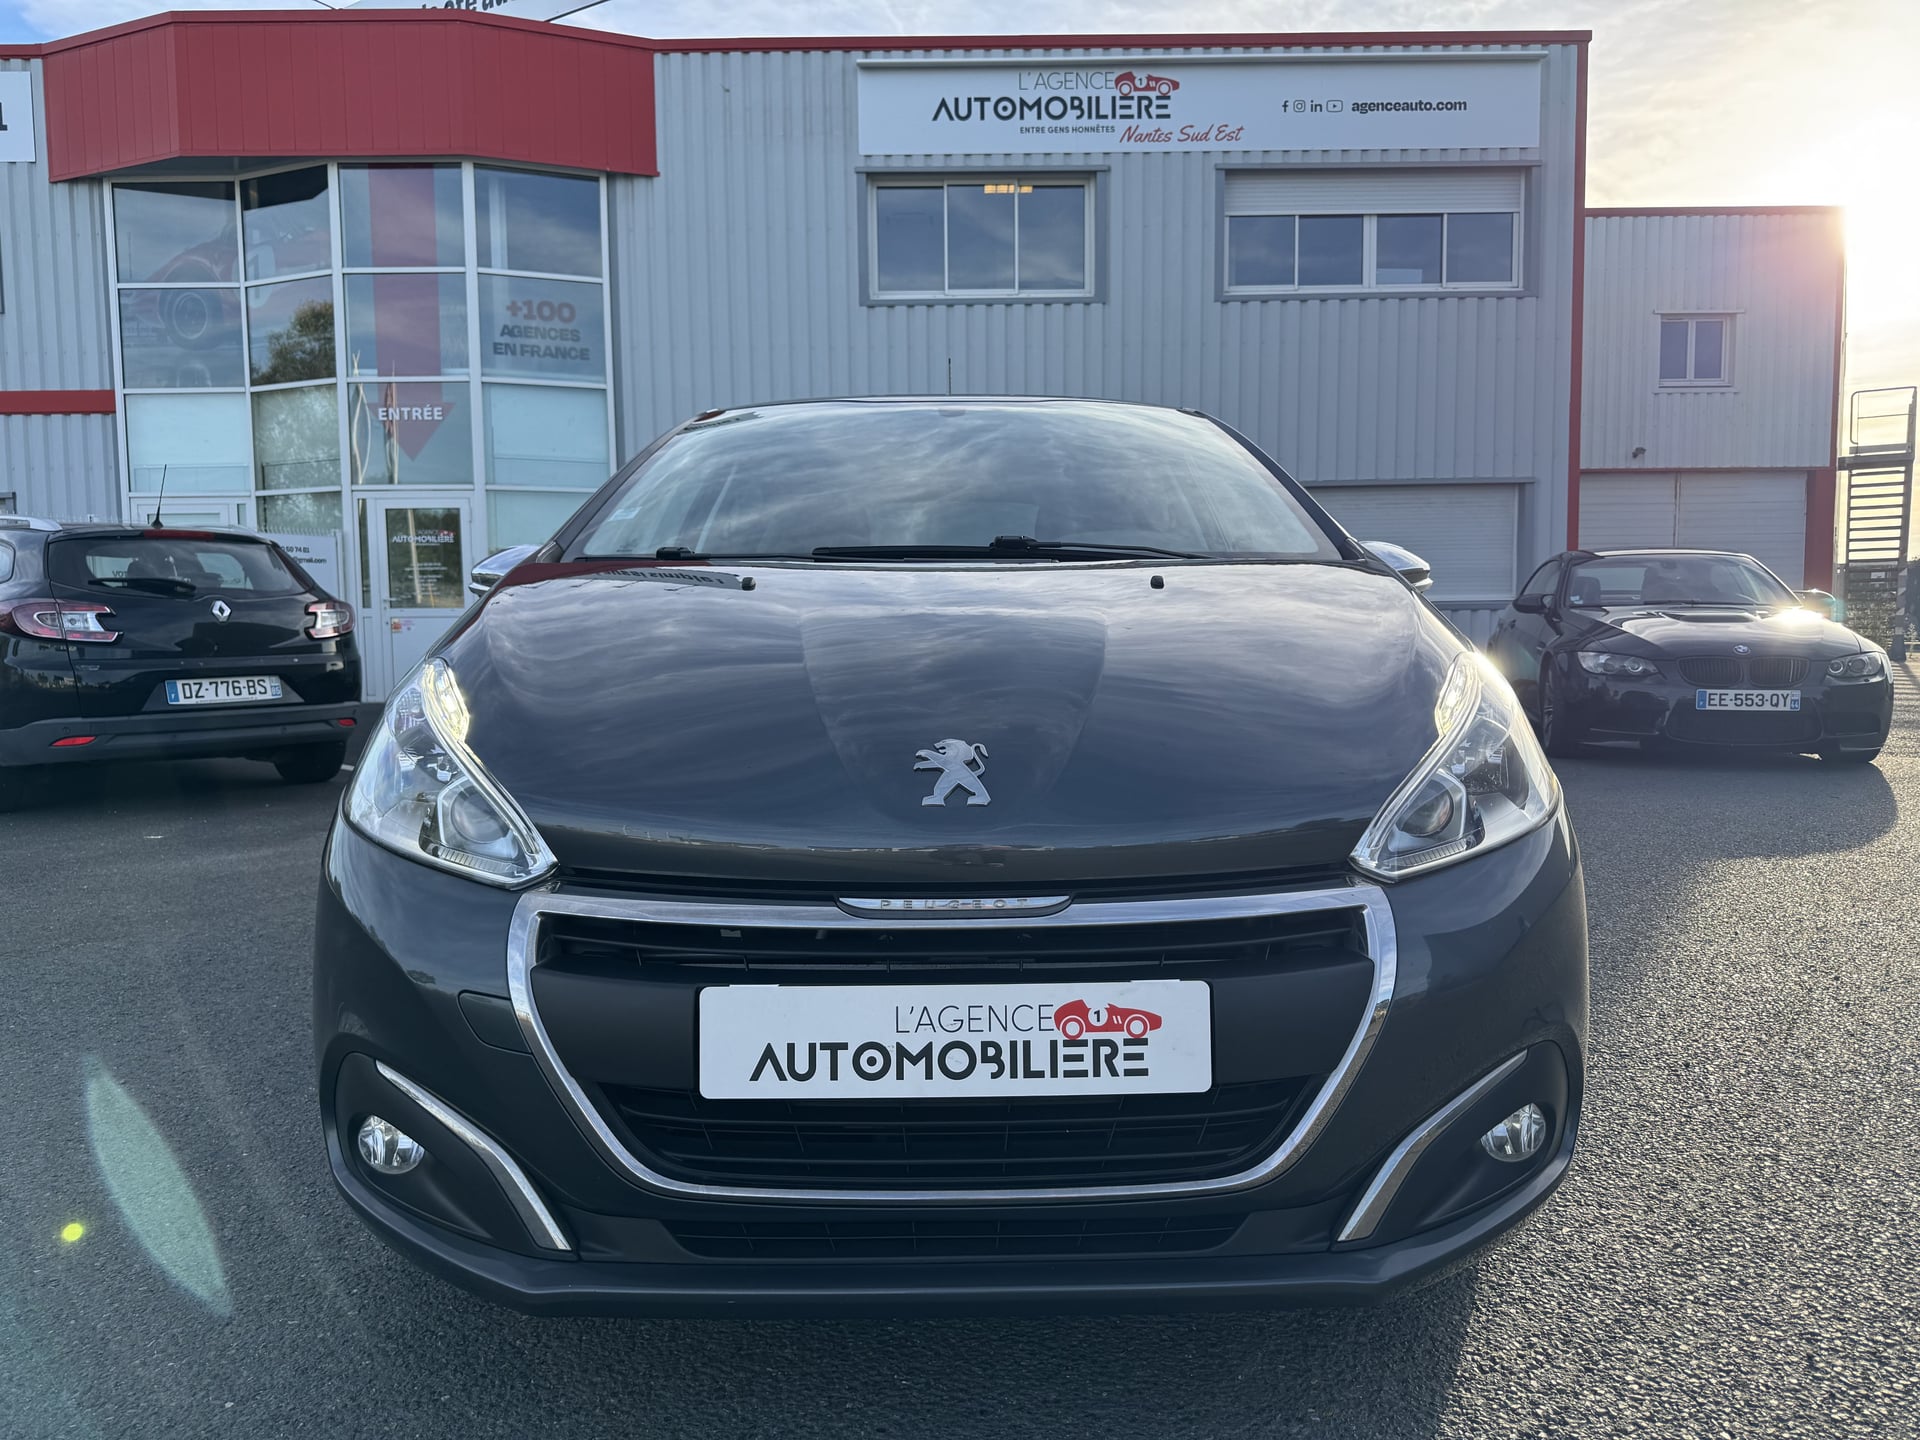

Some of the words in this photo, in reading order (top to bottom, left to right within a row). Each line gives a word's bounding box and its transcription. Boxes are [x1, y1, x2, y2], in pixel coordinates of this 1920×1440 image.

[1018, 72, 1115, 91] L'AGENCE
[1350, 99, 1468, 114] agenceauto.com
[1020, 126, 1046, 134] ENTRE
[1047, 125, 1070, 133] GENS
[1071, 123, 1116, 134] HONNÊTES
[1119, 125, 1174, 143] Nantes
[1177, 124, 1211, 142] Sud
[1215, 123, 1246, 141] Est
[506, 299, 576, 323] +100
[500, 324, 581, 342] AGENCES
[493, 342, 517, 357] EN
[520, 344, 591, 361] FRANCE
[378, 405, 443, 421] ENTRÉE
[181, 679, 267, 699] DZ-776-BS
[1708, 693, 1790, 708] EE-553-QY
[880, 898, 1029, 909] PEUGEOT
[895, 1004, 1055, 1033] L'AGENCE
